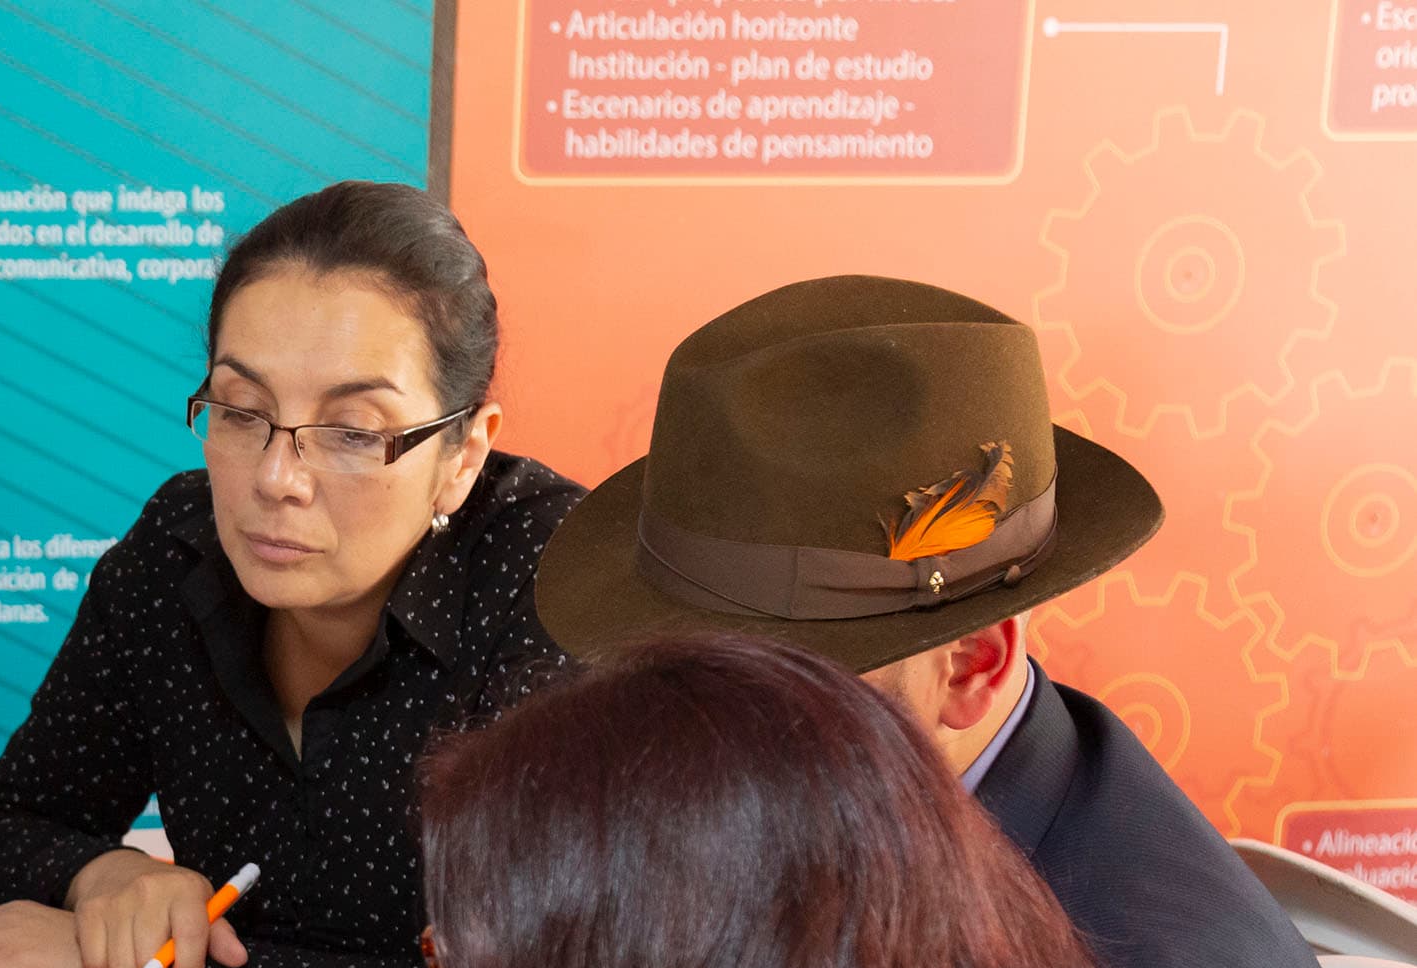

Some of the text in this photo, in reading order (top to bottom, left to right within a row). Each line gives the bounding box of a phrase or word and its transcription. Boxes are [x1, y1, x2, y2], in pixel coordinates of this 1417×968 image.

[566, 9, 859, 41] Articulación horizonte
[569, 50, 709, 80] Institución
[731, 49, 790, 86] plan
[795, 50, 830, 80] de
[835, 50, 933, 81] estudio
[563, 88, 702, 119] Escenarios
[706, 88, 742, 119] de
[1370, 83, 1417, 112] pro
[566, 127, 933, 165] habilidades de pensamiento
[72, 190, 112, 217] que
[118, 185, 187, 217] indaga
[192, 185, 224, 212] los
[36, 224, 62, 246] en
[66, 219, 86, 246] el
[89, 219, 193, 246] desarrollo
[196, 219, 224, 246] de
[13, 534, 42, 559] los
[52, 566, 79, 590] de
